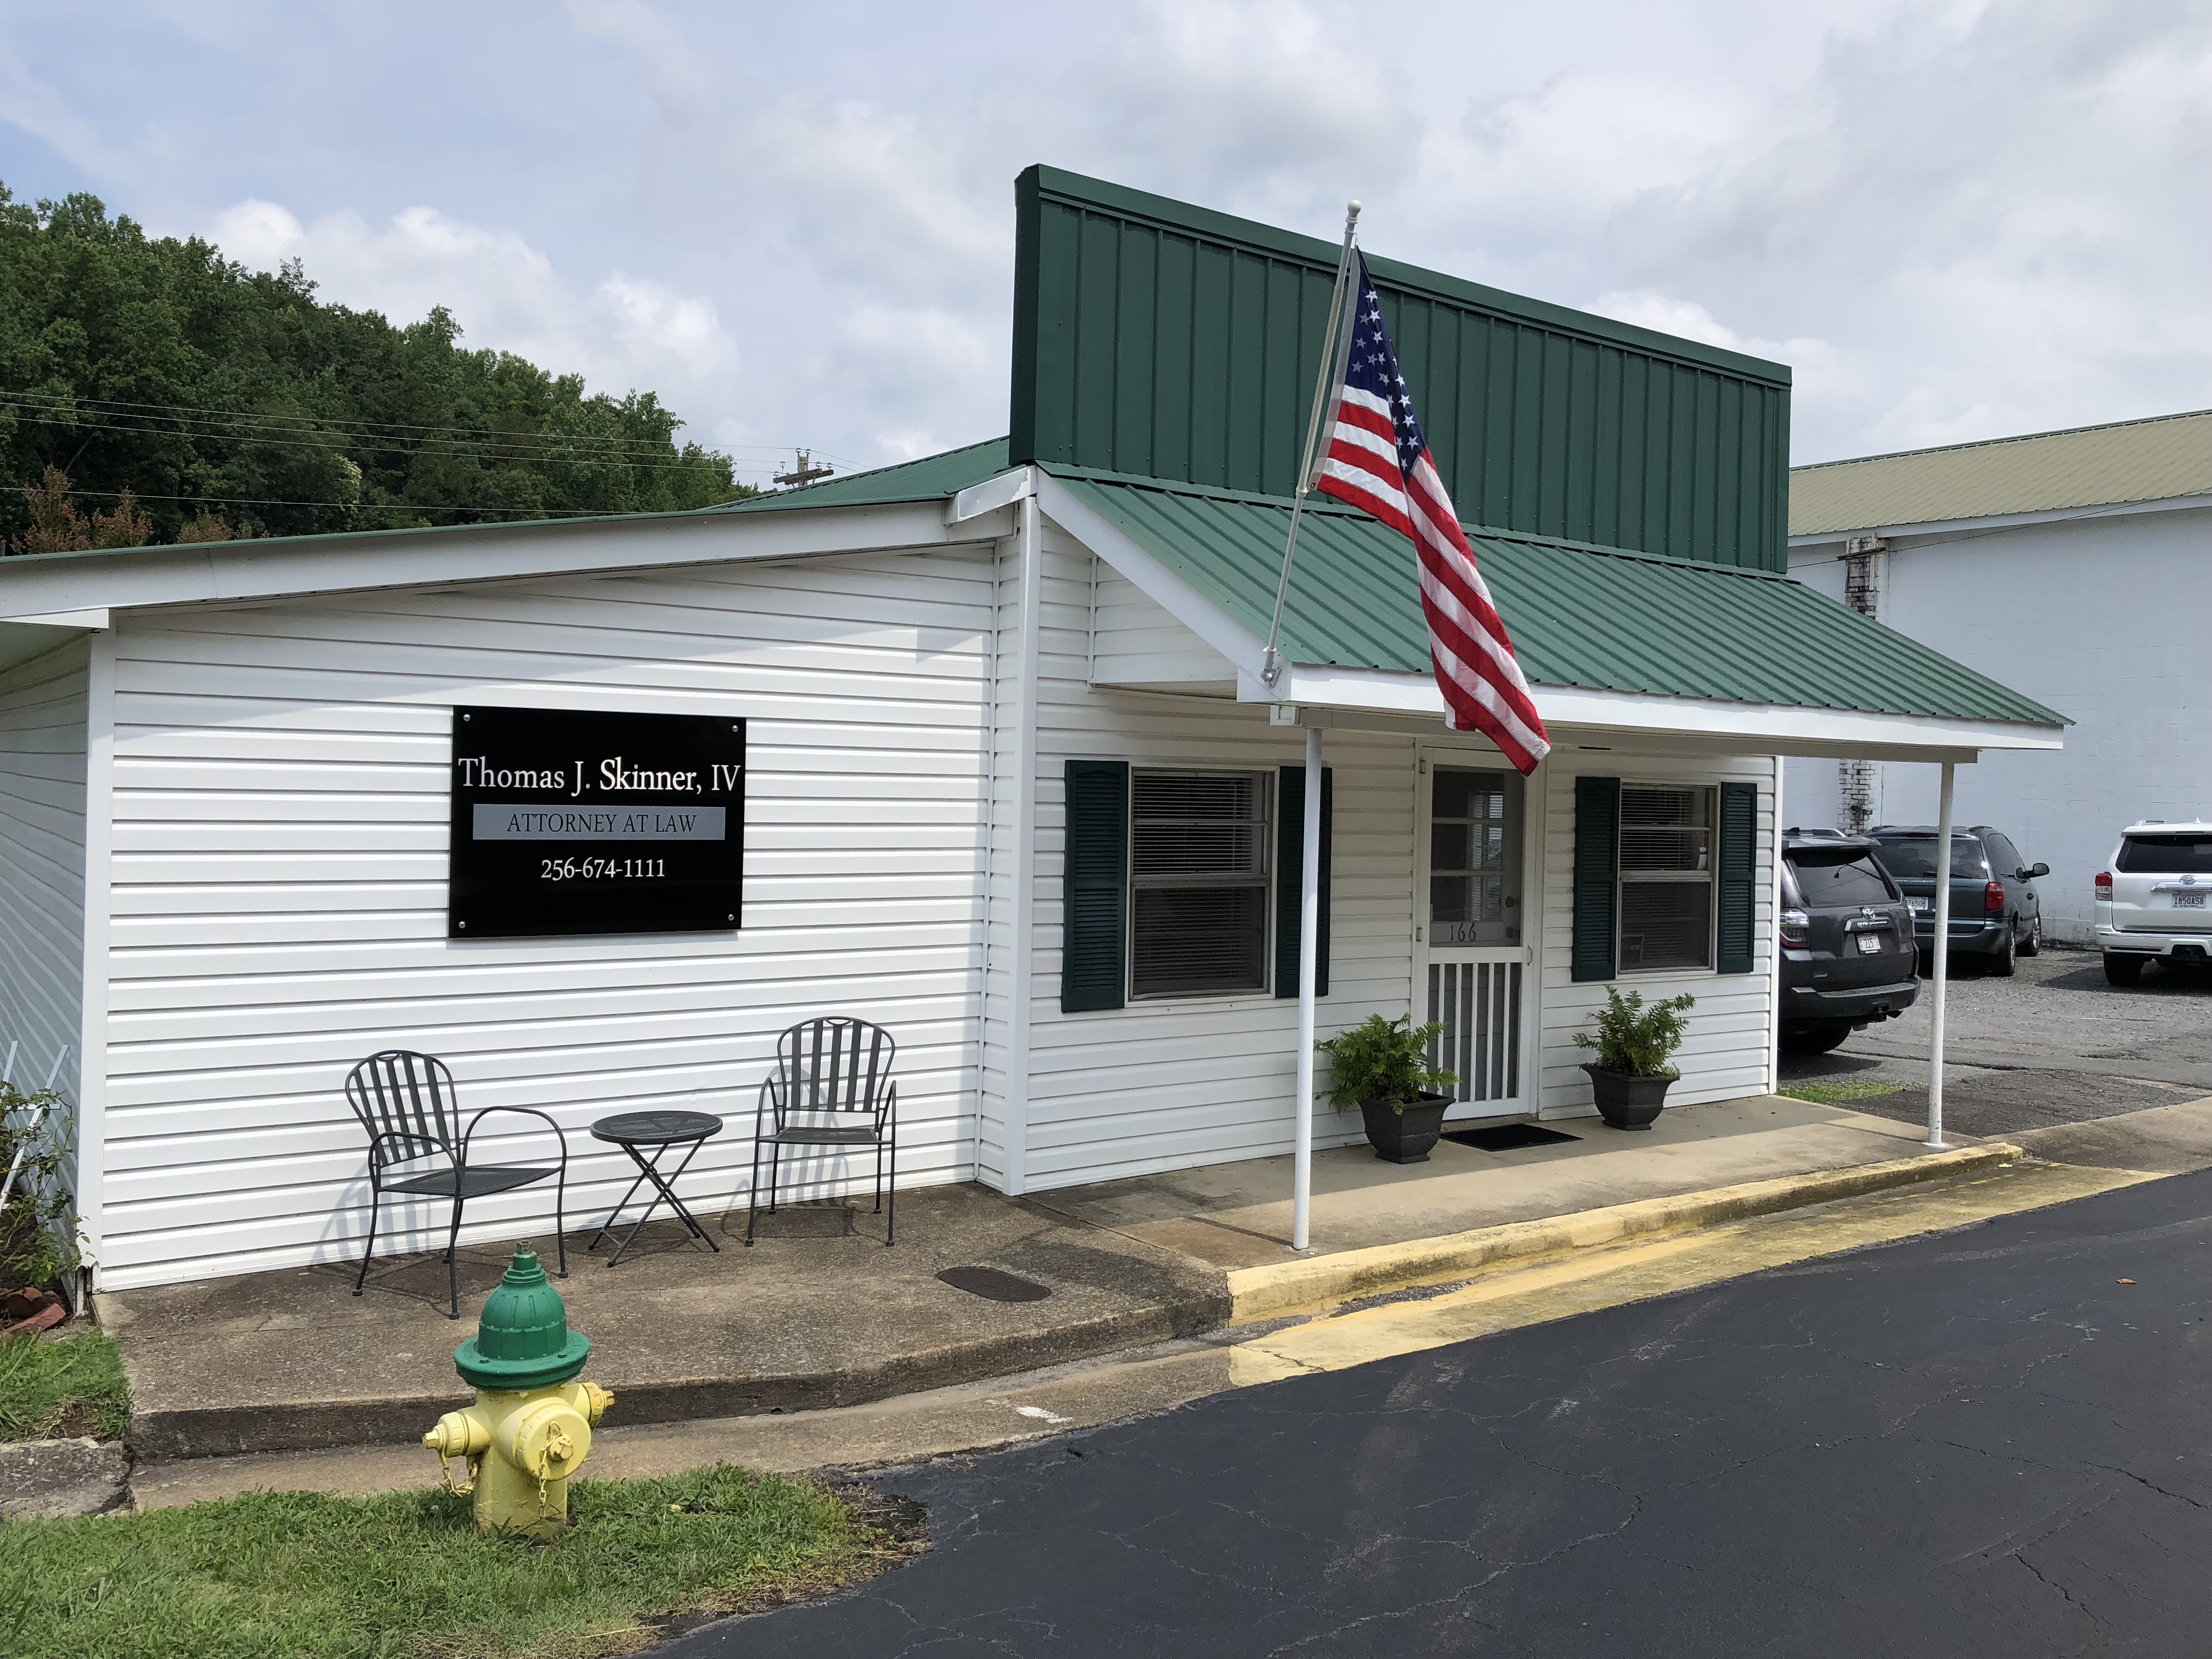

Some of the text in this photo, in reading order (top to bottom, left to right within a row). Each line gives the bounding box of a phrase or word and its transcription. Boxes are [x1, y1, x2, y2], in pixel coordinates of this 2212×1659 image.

[458, 755, 741, 797] Thomas J. Skinner, IV
[506, 813, 697, 833] ATTORNEY AT LAW
[540, 856, 665, 881] 256-674-1111
[1450, 922, 1476, 941] 166
